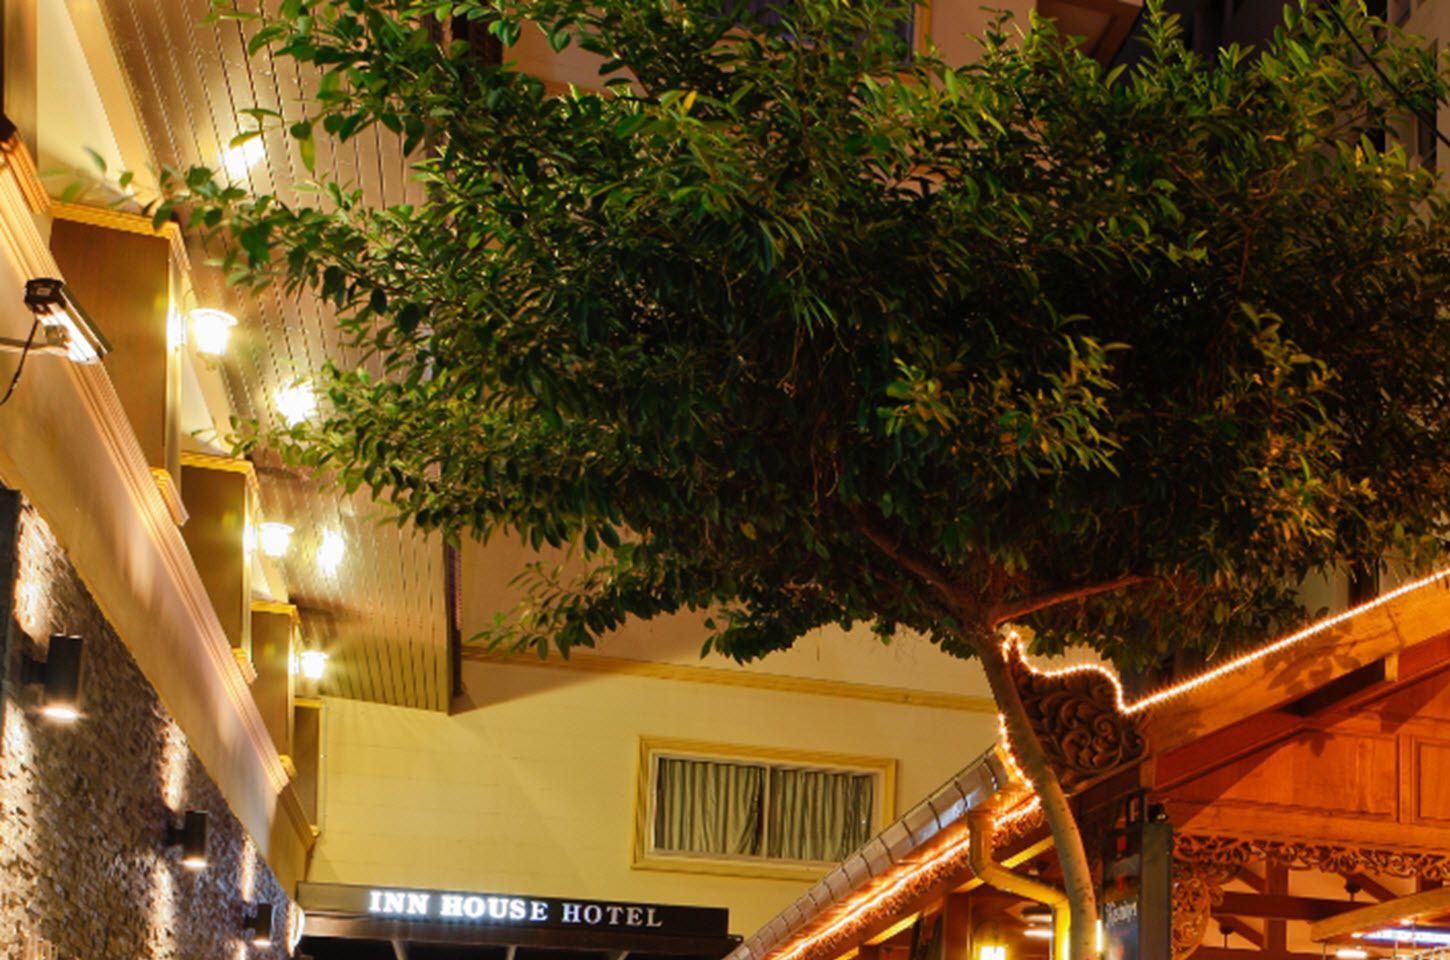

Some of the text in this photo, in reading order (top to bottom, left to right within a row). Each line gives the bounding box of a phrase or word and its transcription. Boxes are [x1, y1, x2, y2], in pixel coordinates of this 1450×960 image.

[370, 890, 662, 927] INN HOUSE HOTEL
